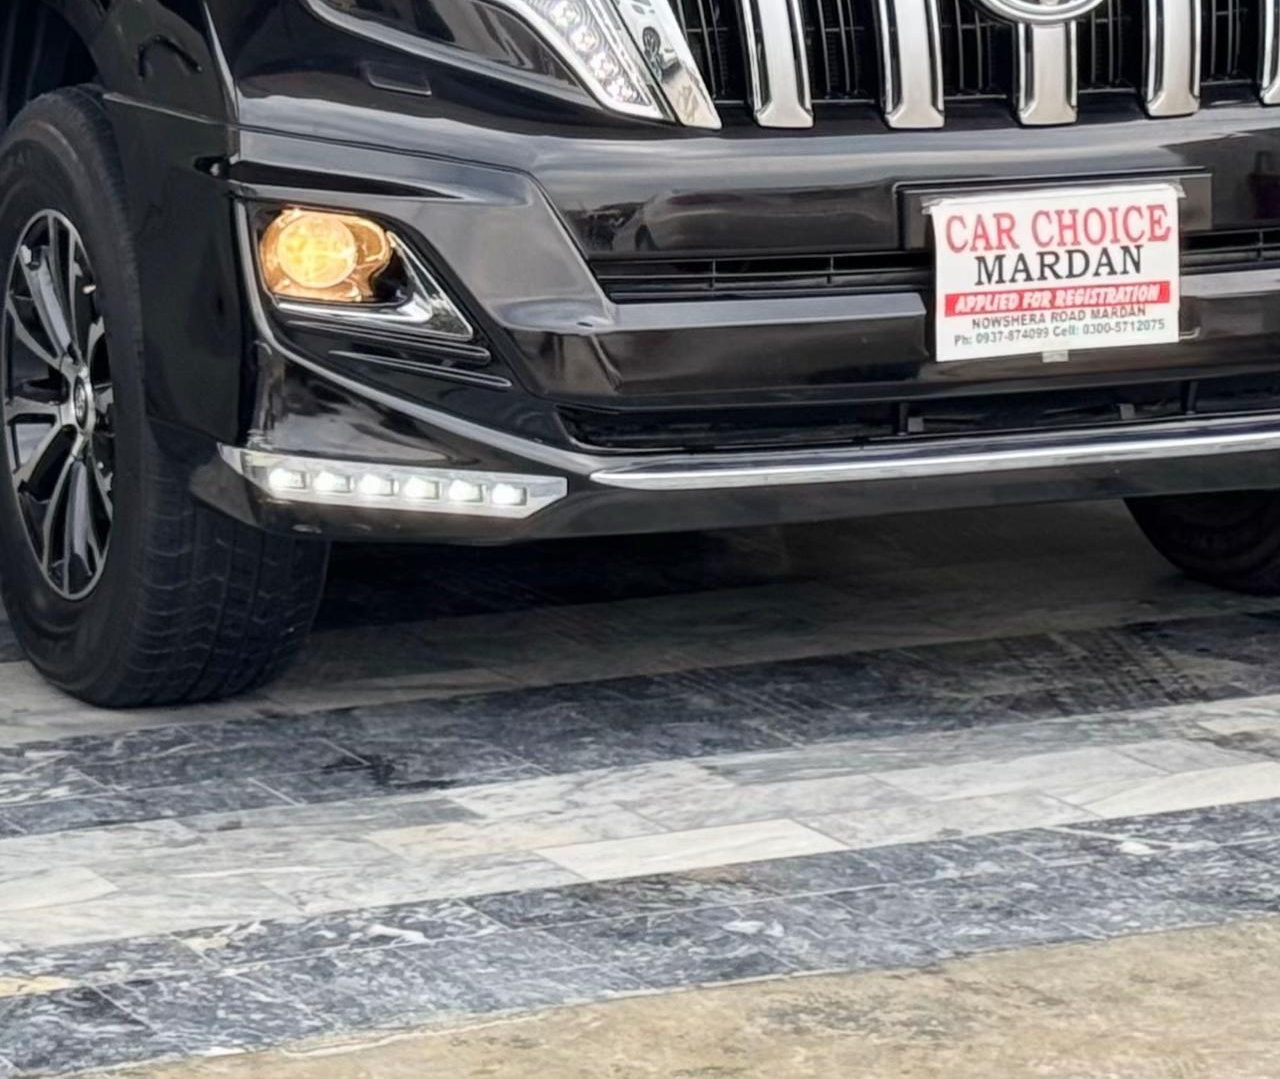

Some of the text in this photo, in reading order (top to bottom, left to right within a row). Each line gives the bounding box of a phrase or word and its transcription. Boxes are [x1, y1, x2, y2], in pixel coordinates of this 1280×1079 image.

[945, 204, 1171, 253] CAR CHOICE
[974, 245, 1143, 286] MARDAN
[954, 283, 1160, 314] APPLIED FOR REGISTRATION
[954, 334, 973, 346] Ph:
[1053, 325, 1079, 337] Cell:
[1082, 318, 1165, 335] 0300-5712075
[972, 305, 1146, 329] NOWSHERA ROAD MARDAN
